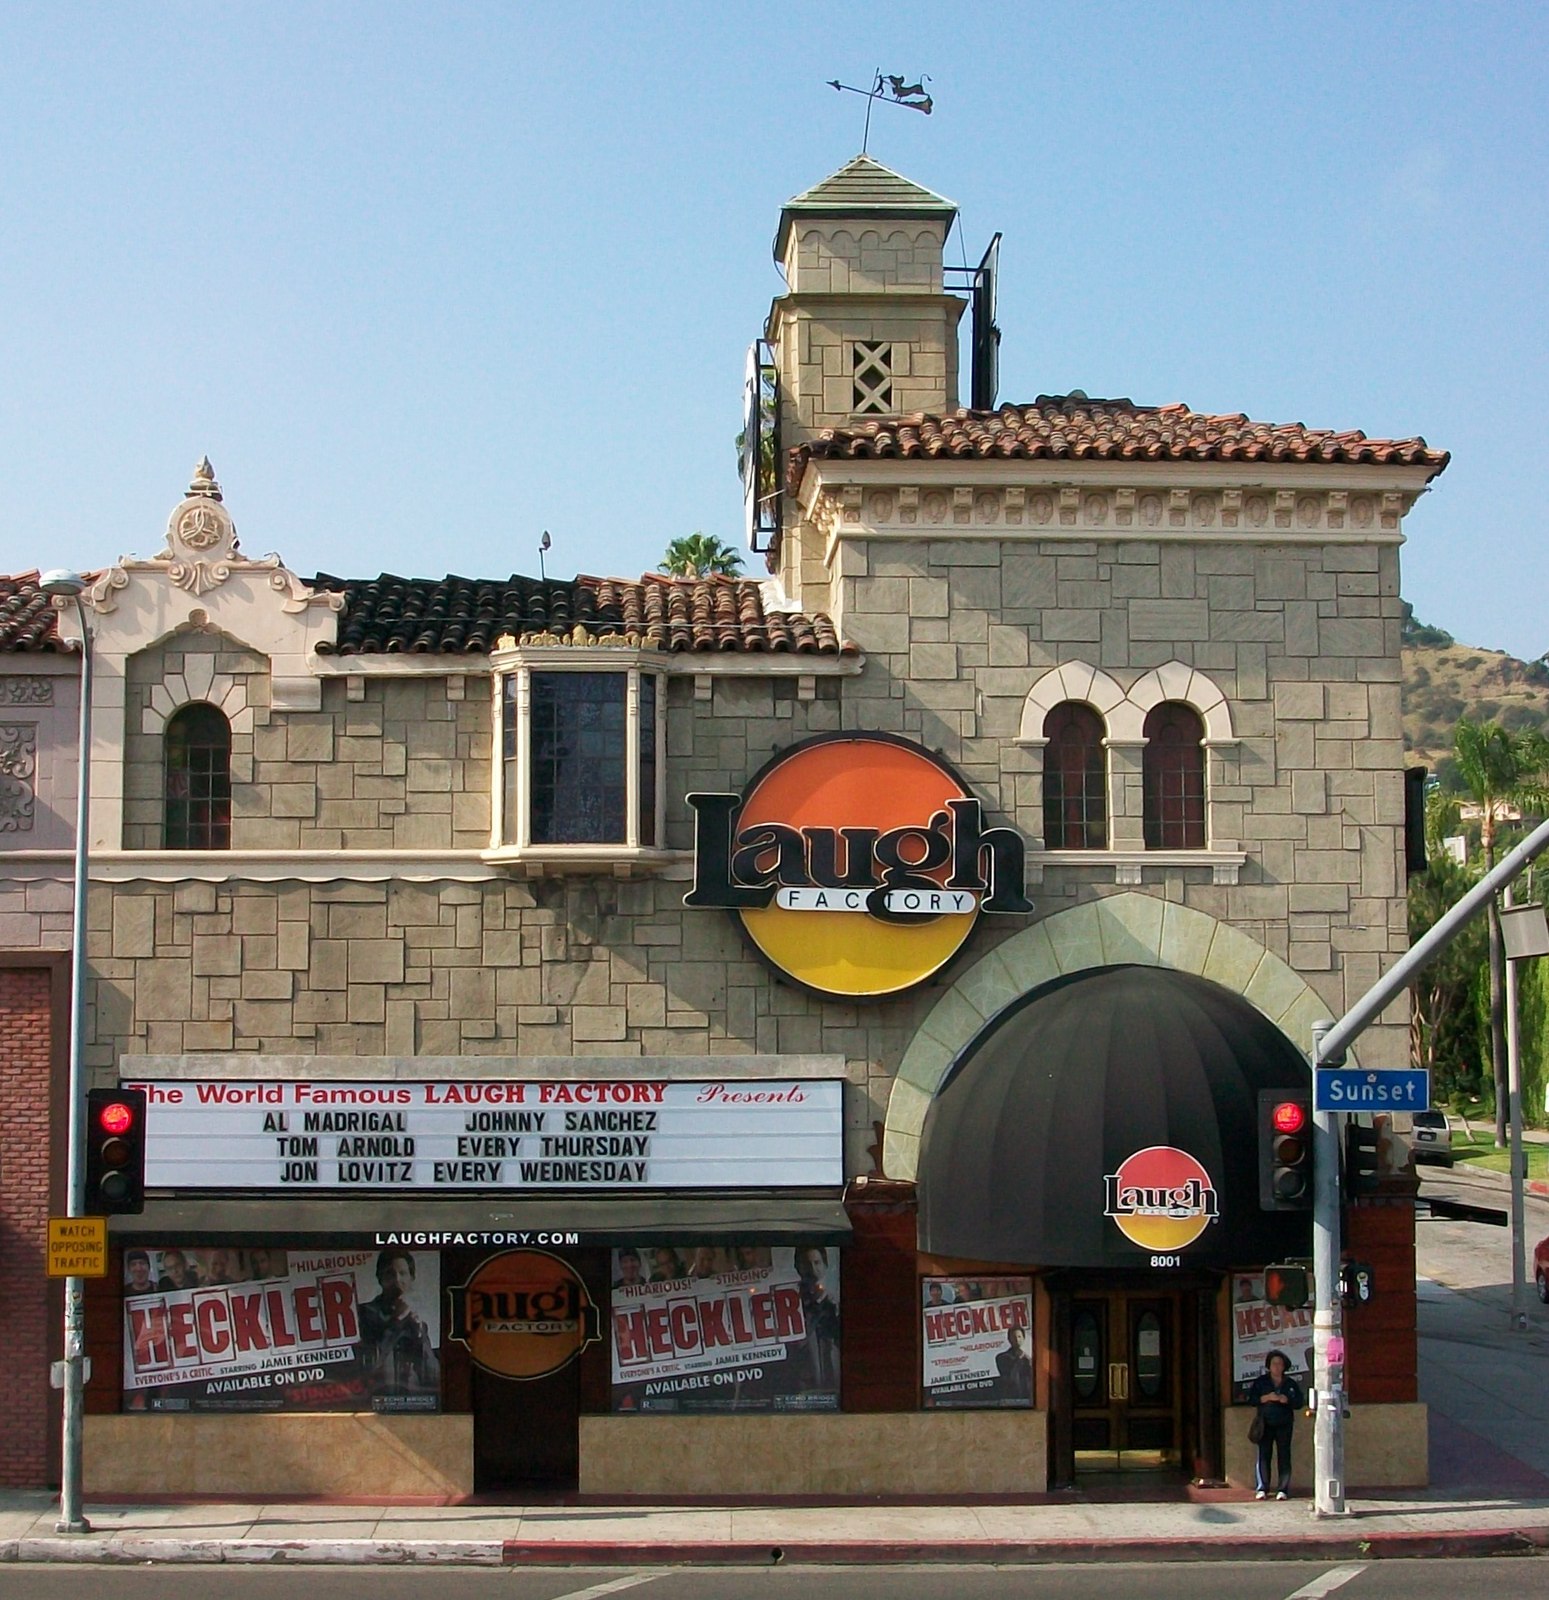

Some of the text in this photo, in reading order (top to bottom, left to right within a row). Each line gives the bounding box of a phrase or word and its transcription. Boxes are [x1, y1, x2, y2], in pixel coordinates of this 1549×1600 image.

[684, 792, 1034, 927] Laugh
[788, 891, 966, 909] FACTORY
[196, 1085, 283, 1103] World
[295, 1085, 411, 1104] Famous
[424, 1084, 524, 1103] LAUGH
[538, 1083, 668, 1103] FACTORY
[696, 1083, 810, 1104] Presents
[1330, 1080, 1415, 1100] Sunset
[263, 1111, 657, 1132] AL MADRIGAL JOHNNY SANCHEZ
[277, 1136, 648, 1157] TOM ARNOLD EVERY THURSDAY
[280, 1162, 646, 1182] JON LOVITZ EVERY WEDNESDAY
[1103, 1175, 1220, 1220] Laugh
[60, 1226, 95, 1236] WATCH
[375, 1232, 579, 1245] LAUGHFACTORY.COM
[51, 1242, 102, 1252] OPPOSING
[54, 1257, 99, 1268] TRAFFIC
[1150, 1256, 1180, 1267] 8001
[129, 1281, 358, 1366] HECKLER
[487, 1322, 574, 1331] FACTORY
[617, 1289, 803, 1361] HECKLER
[925, 1301, 1028, 1340] HECKLER
[135, 1370, 180, 1386] EVERYONE'S
[182, 1369, 188, 1379] A
[220, 1363, 257, 1374] STARRING
[260, 1355, 293, 1369] JAMIE
[296, 1348, 349, 1363] KENNEDY
[715, 1354, 739, 1365] JAMIE
[742, 1349, 783, 1361] KENNEDY
[206, 1368, 324, 1394] AVAILABLE ON DVD
[645, 1368, 763, 1395] AVAILABLE ON DVD
[931, 1375, 952, 1384] JAMIE
[954, 1370, 991, 1380] KENNEDY
